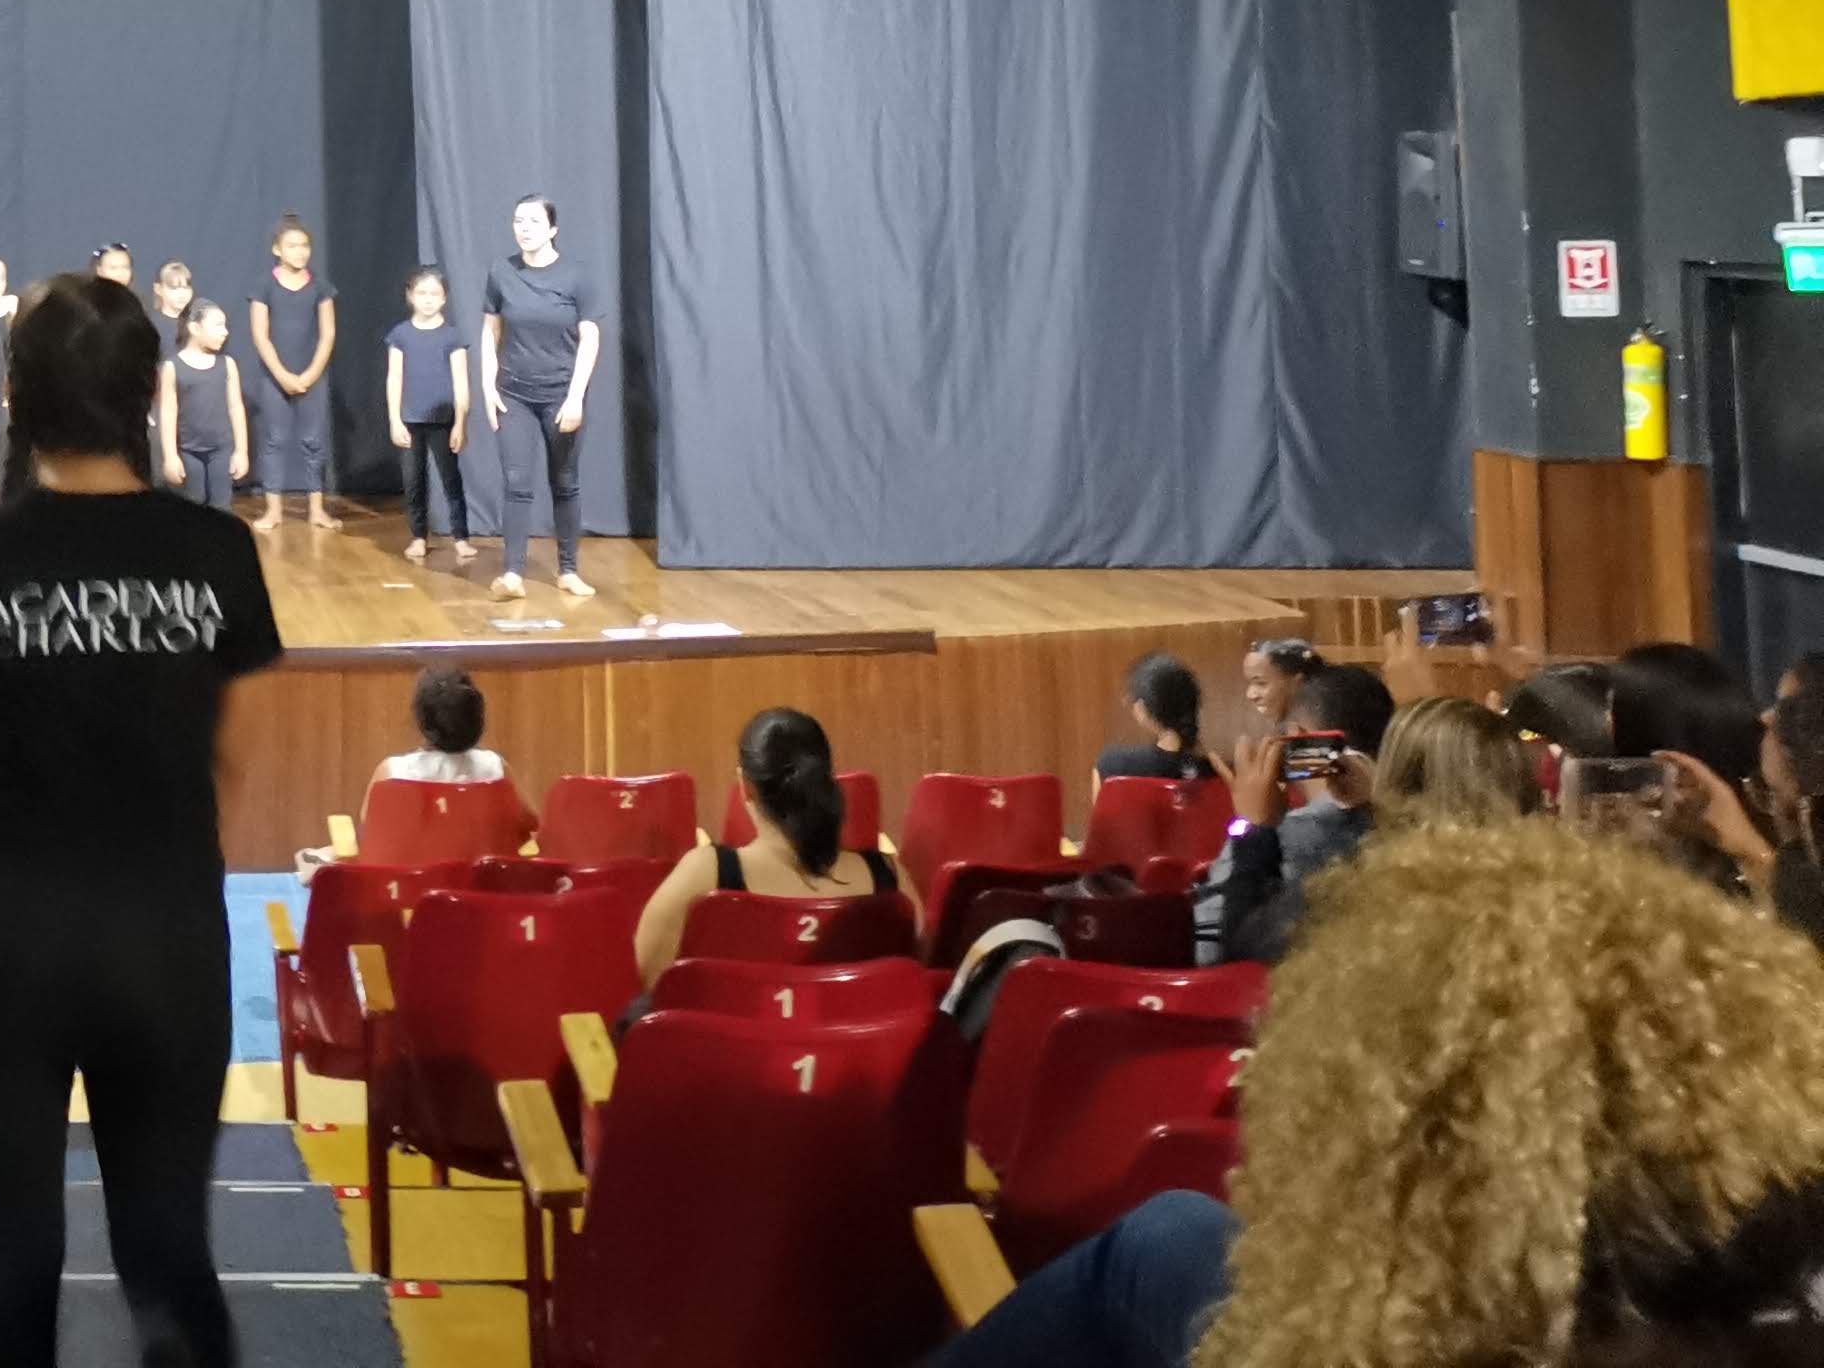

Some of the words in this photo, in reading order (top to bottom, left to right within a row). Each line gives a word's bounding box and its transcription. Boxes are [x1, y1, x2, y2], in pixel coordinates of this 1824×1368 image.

[435, 797, 448, 814] 1
[619, 790, 637, 809] 2
[387, 880, 399, 900] 1
[519, 915, 536, 942] 1
[796, 915, 819, 942] 2
[1075, 914, 1097, 941] 3
[773, 988, 794, 1019] 1
[791, 1054, 817, 1093] 1
